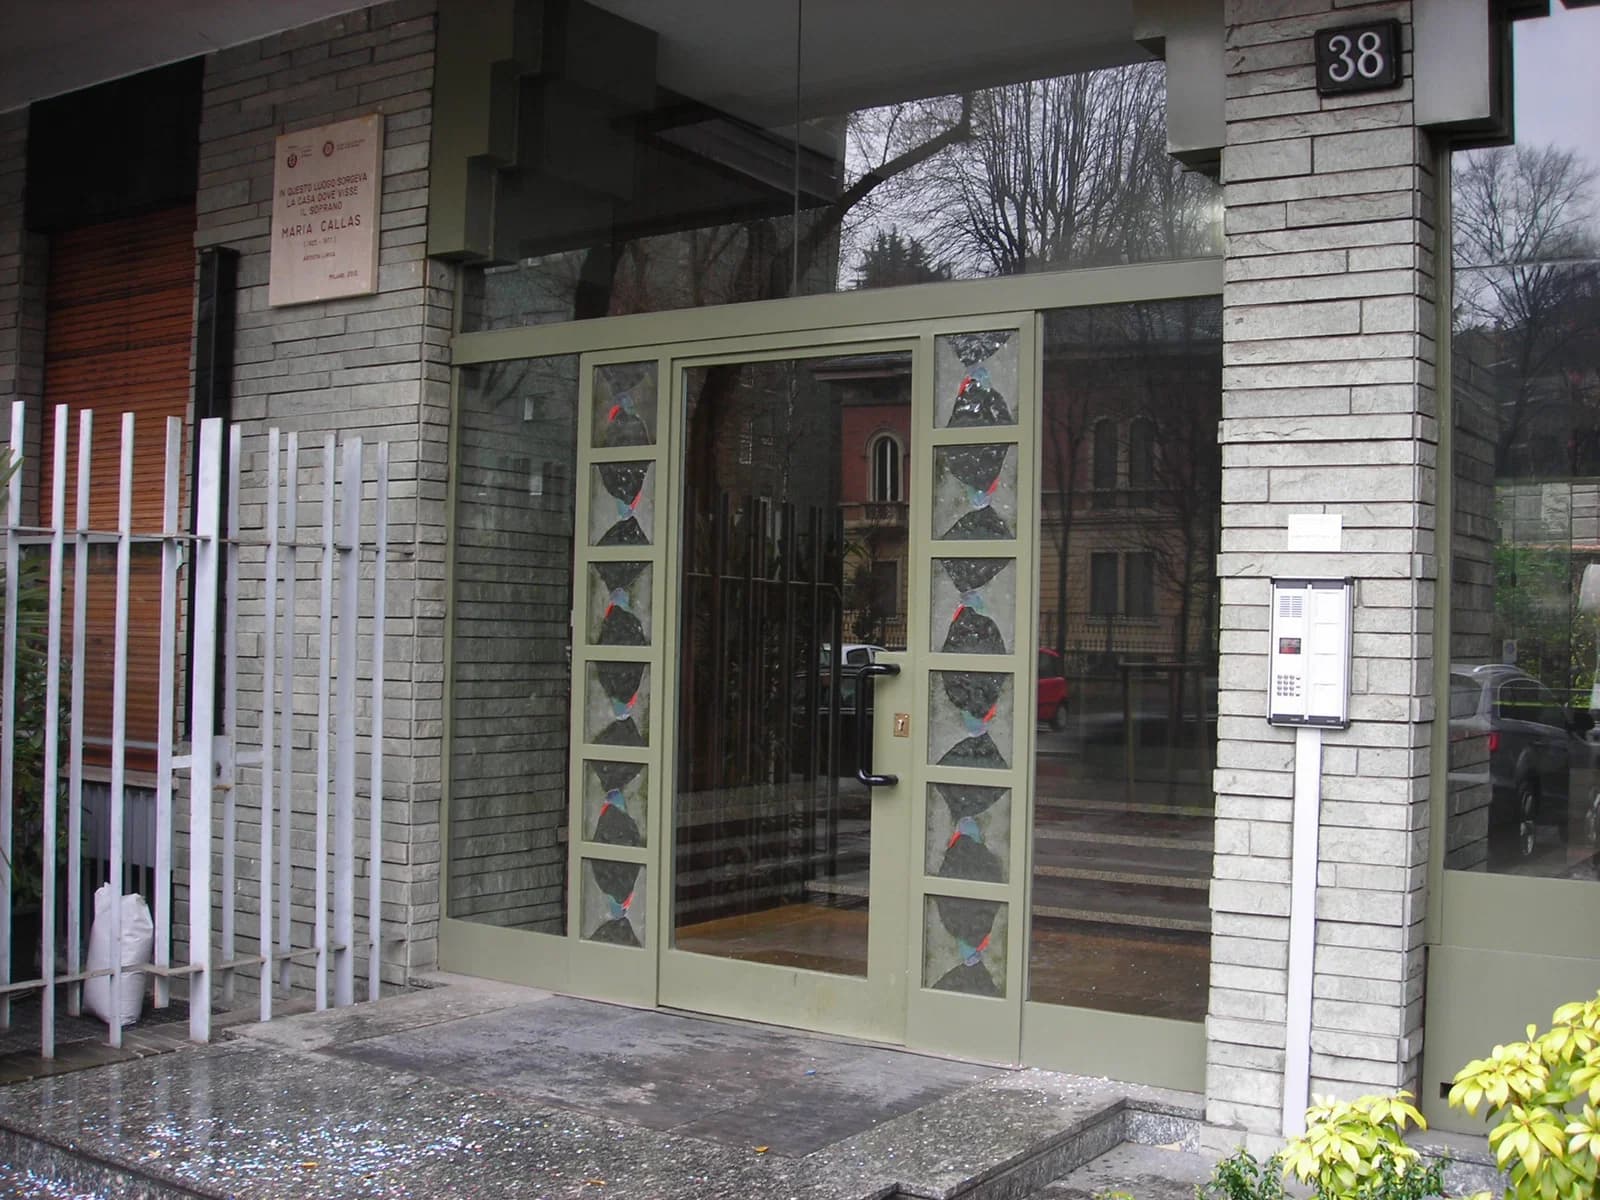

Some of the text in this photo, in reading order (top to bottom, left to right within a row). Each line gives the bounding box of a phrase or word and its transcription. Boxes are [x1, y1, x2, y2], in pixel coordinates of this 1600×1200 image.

[1329, 31, 1384, 82] 38
[287, 184, 312, 196] QUESTO
[313, 179, 335, 191] LUOGO
[337, 172, 367, 186] SORGEVA
[287, 185, 358, 208] LA CASA DOVE VISSE
[309, 201, 342, 215] SOPRANO
[281, 214, 361, 238] MARIA CALLAS
